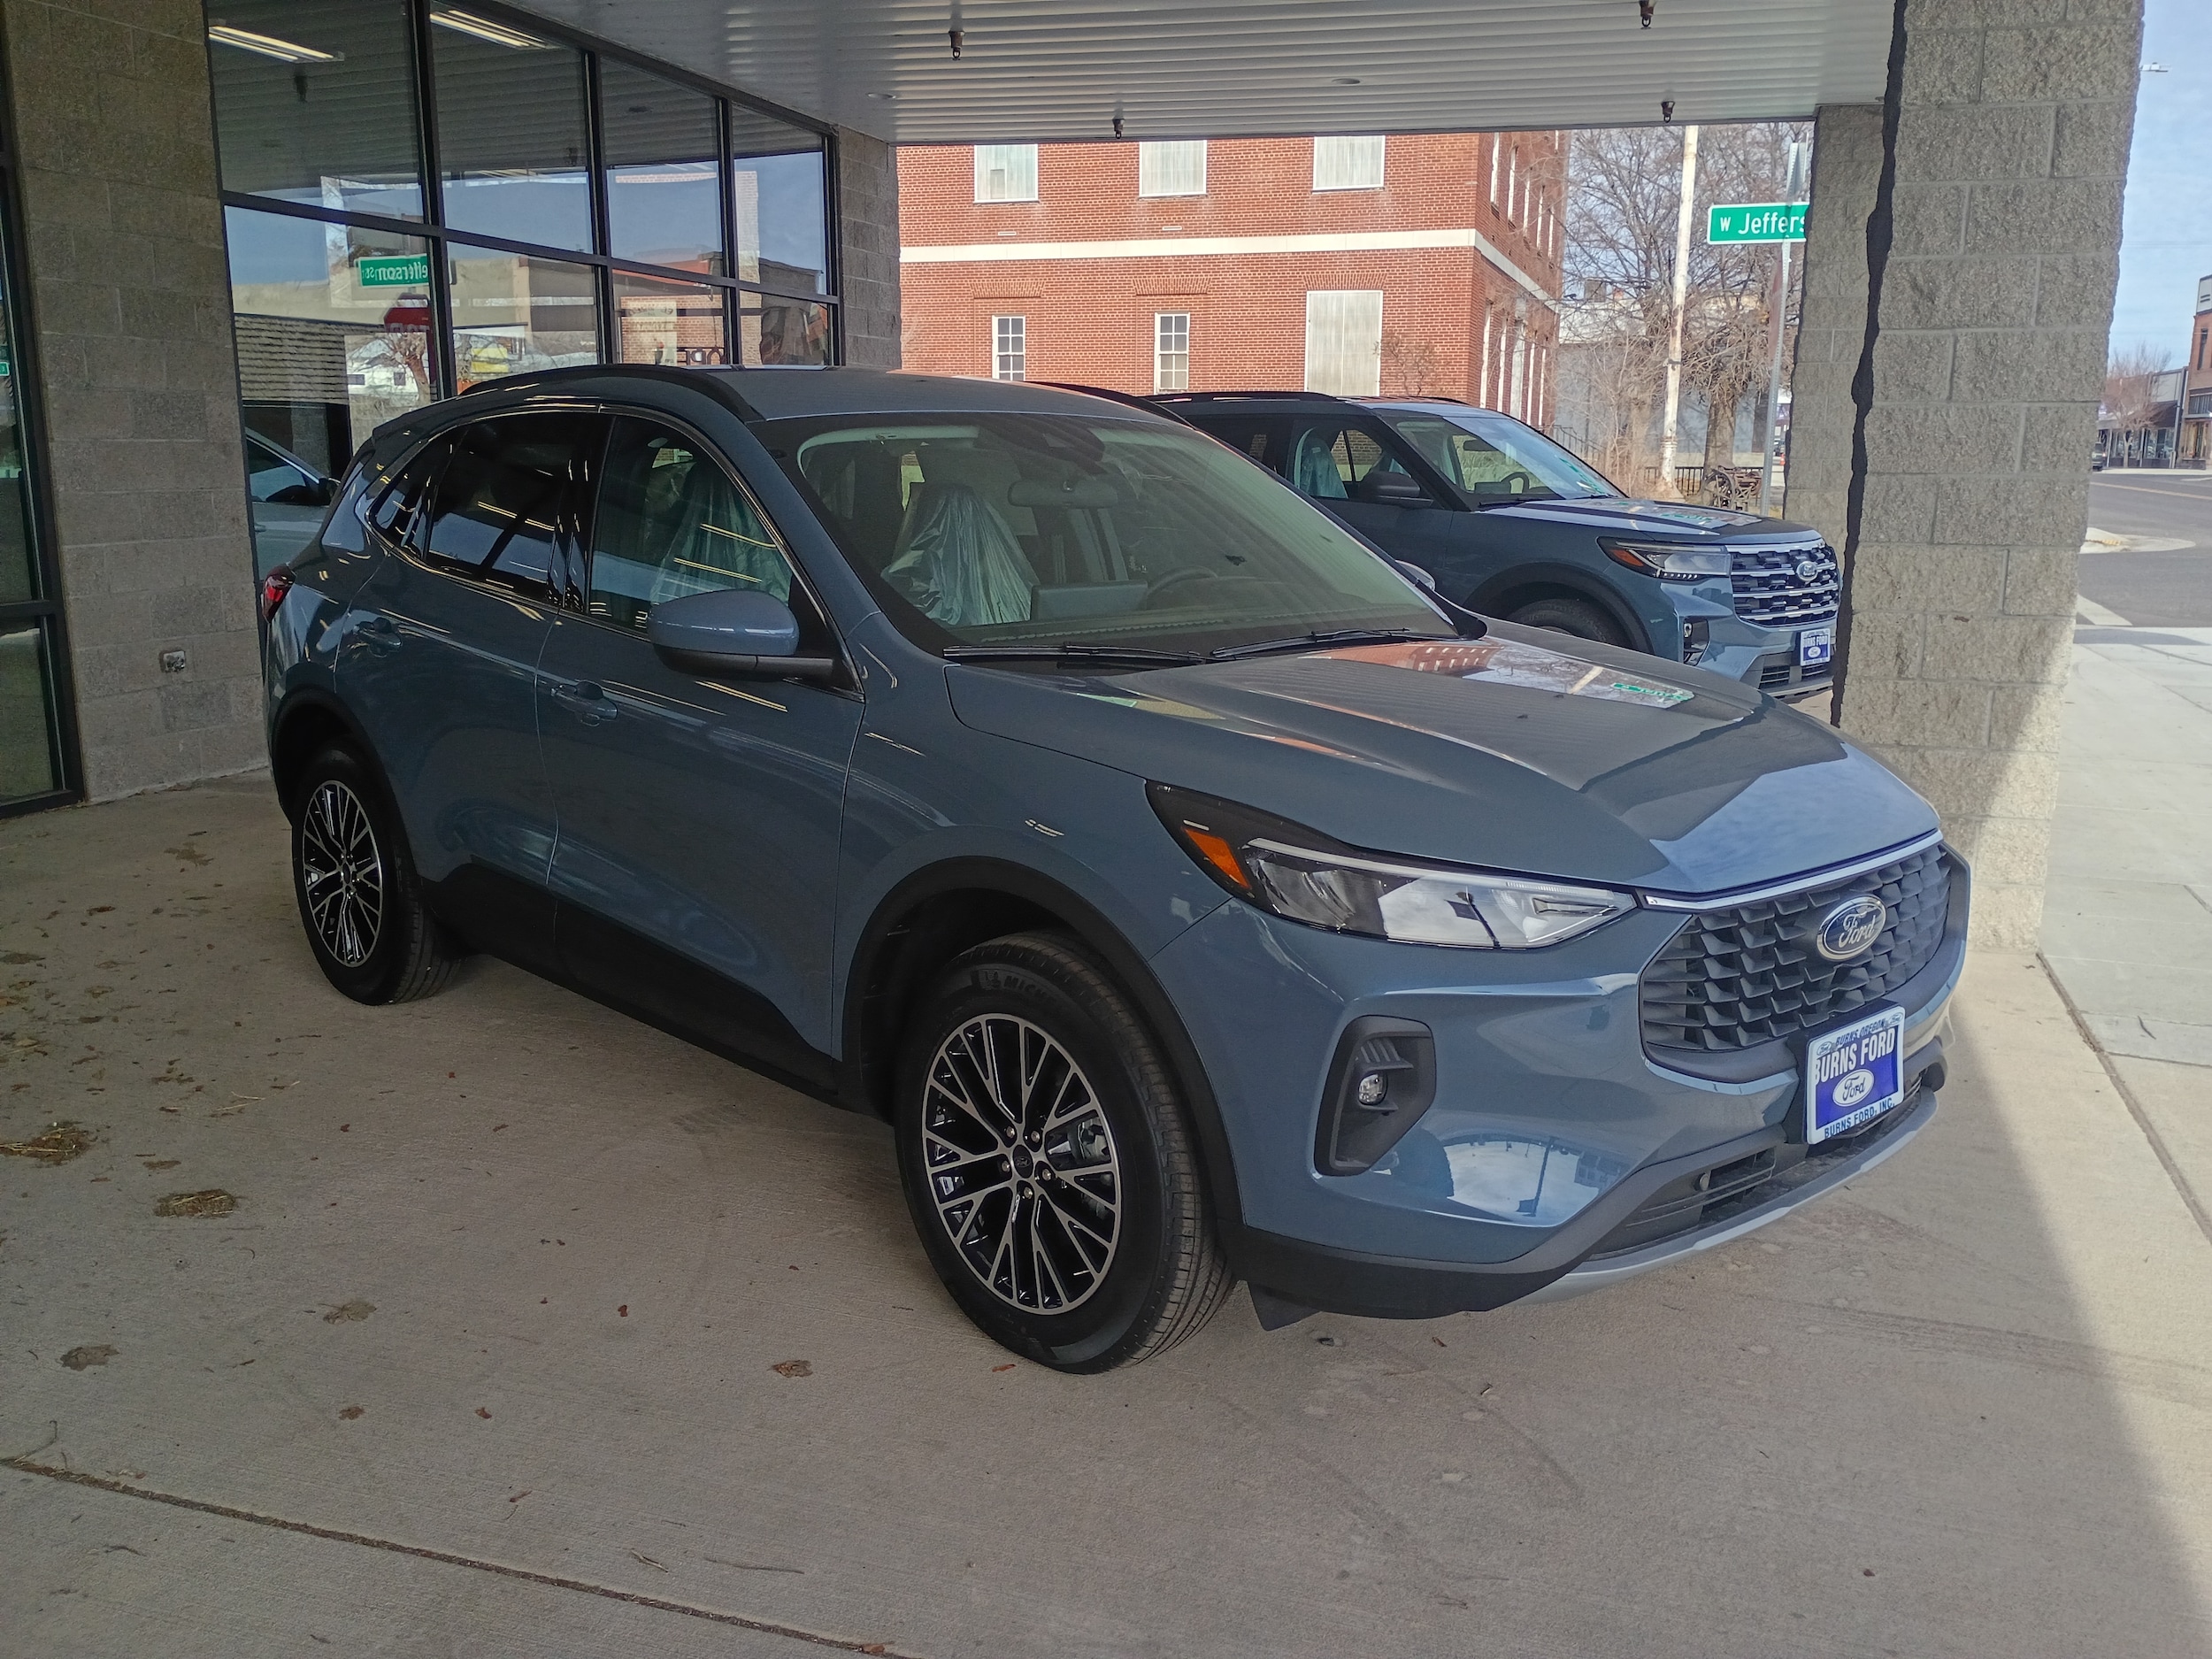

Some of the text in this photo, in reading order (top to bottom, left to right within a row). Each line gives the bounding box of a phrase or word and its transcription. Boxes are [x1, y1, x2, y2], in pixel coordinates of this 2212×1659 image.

[1720, 217, 1732, 232] W
[1838, 910, 1877, 949] Ford
[1814, 1027, 1895, 1086] BURNS FORD
[1842, 1074, 1866, 1102] Ford
[1824, 1117, 1852, 1140] BURNS
[1879, 1097, 1895, 1113] INC.
